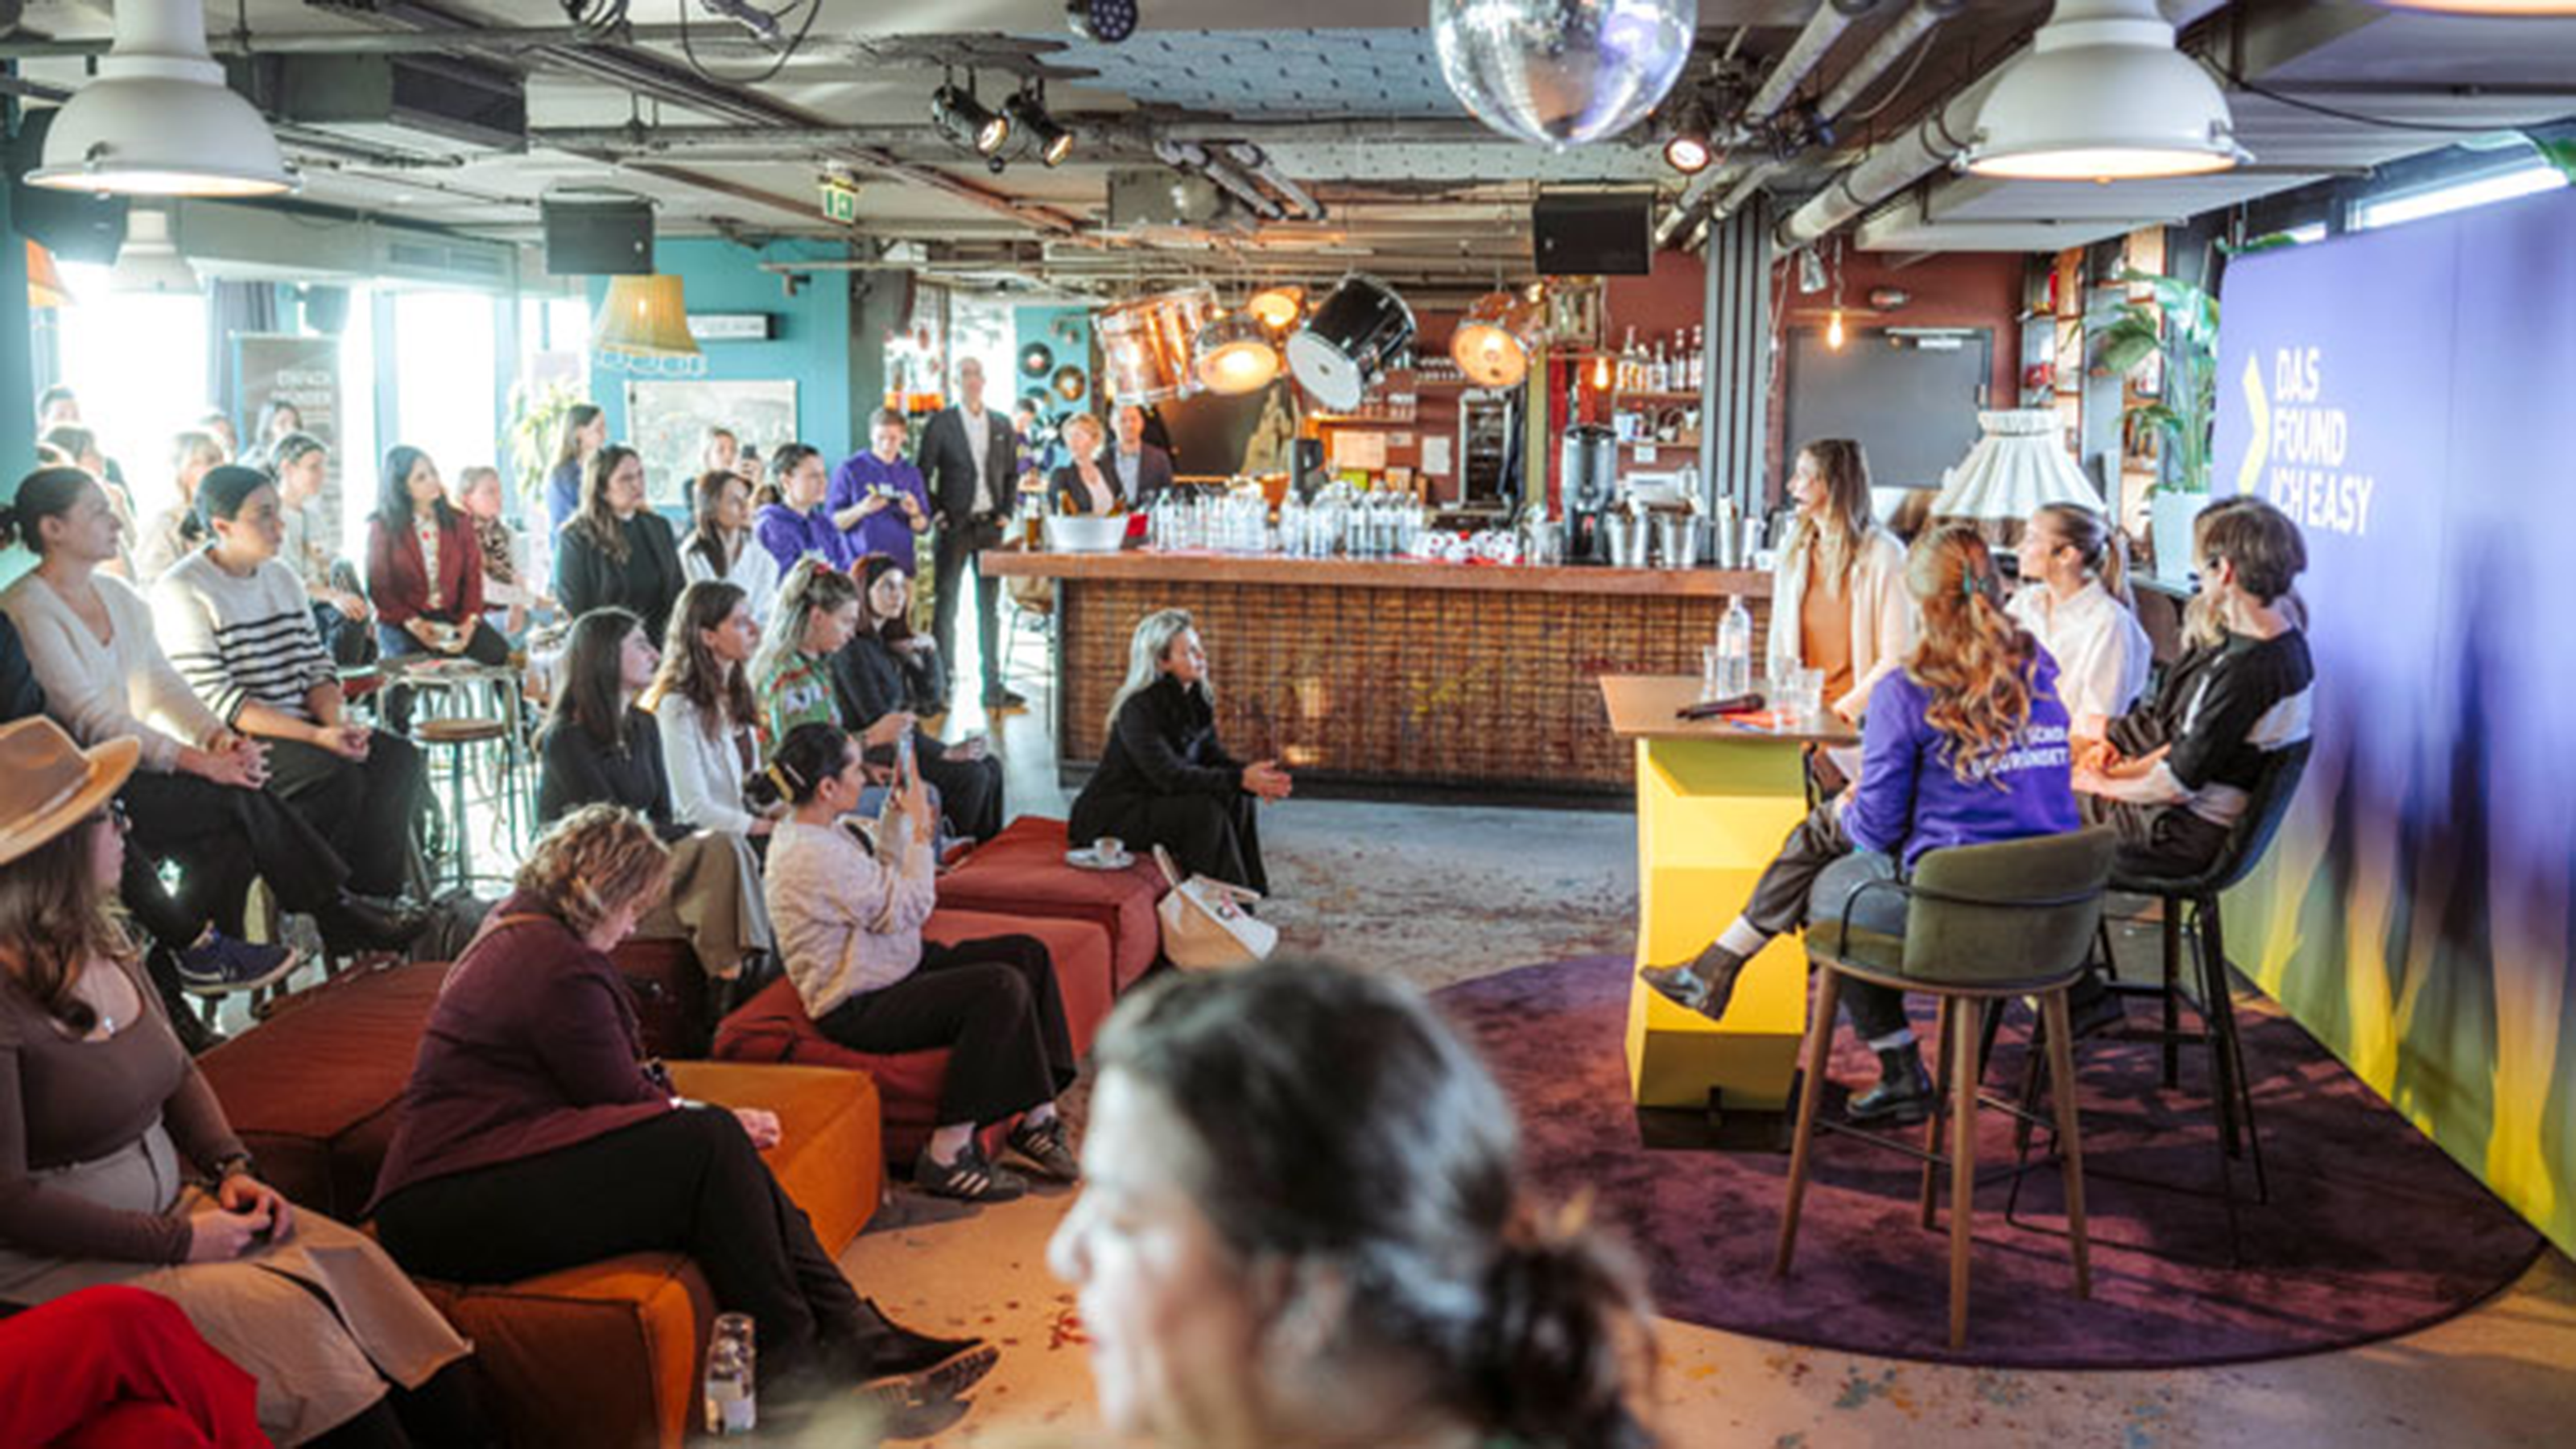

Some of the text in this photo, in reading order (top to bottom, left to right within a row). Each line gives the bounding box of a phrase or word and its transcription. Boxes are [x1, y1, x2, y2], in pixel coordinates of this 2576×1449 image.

[2275, 347, 2320, 402] DAS
[2272, 407, 2347, 467] FOUND
[2268, 466, 2374, 536] ICH EASY
[2027, 726, 2066, 745] SCHO
